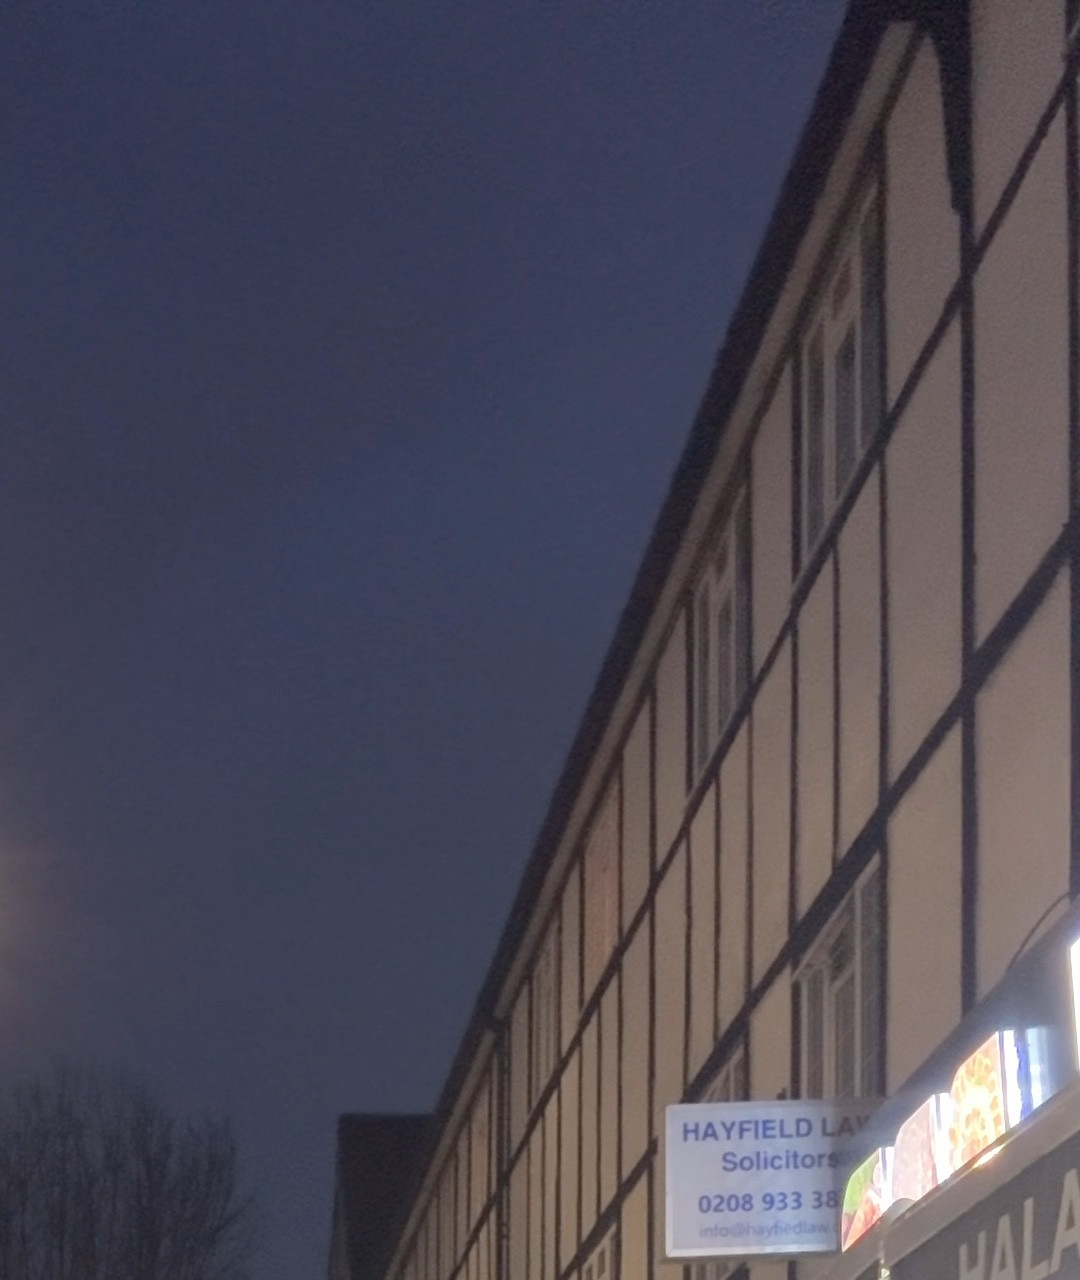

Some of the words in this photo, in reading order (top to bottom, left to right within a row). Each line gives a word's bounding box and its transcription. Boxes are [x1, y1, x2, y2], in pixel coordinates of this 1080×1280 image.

[682, 1117, 813, 1142] HAYFIELD
[721, 1149, 840, 1173] Solicitors
[697, 1193, 755, 1214] 0208
[761, 1192, 804, 1212] 933
